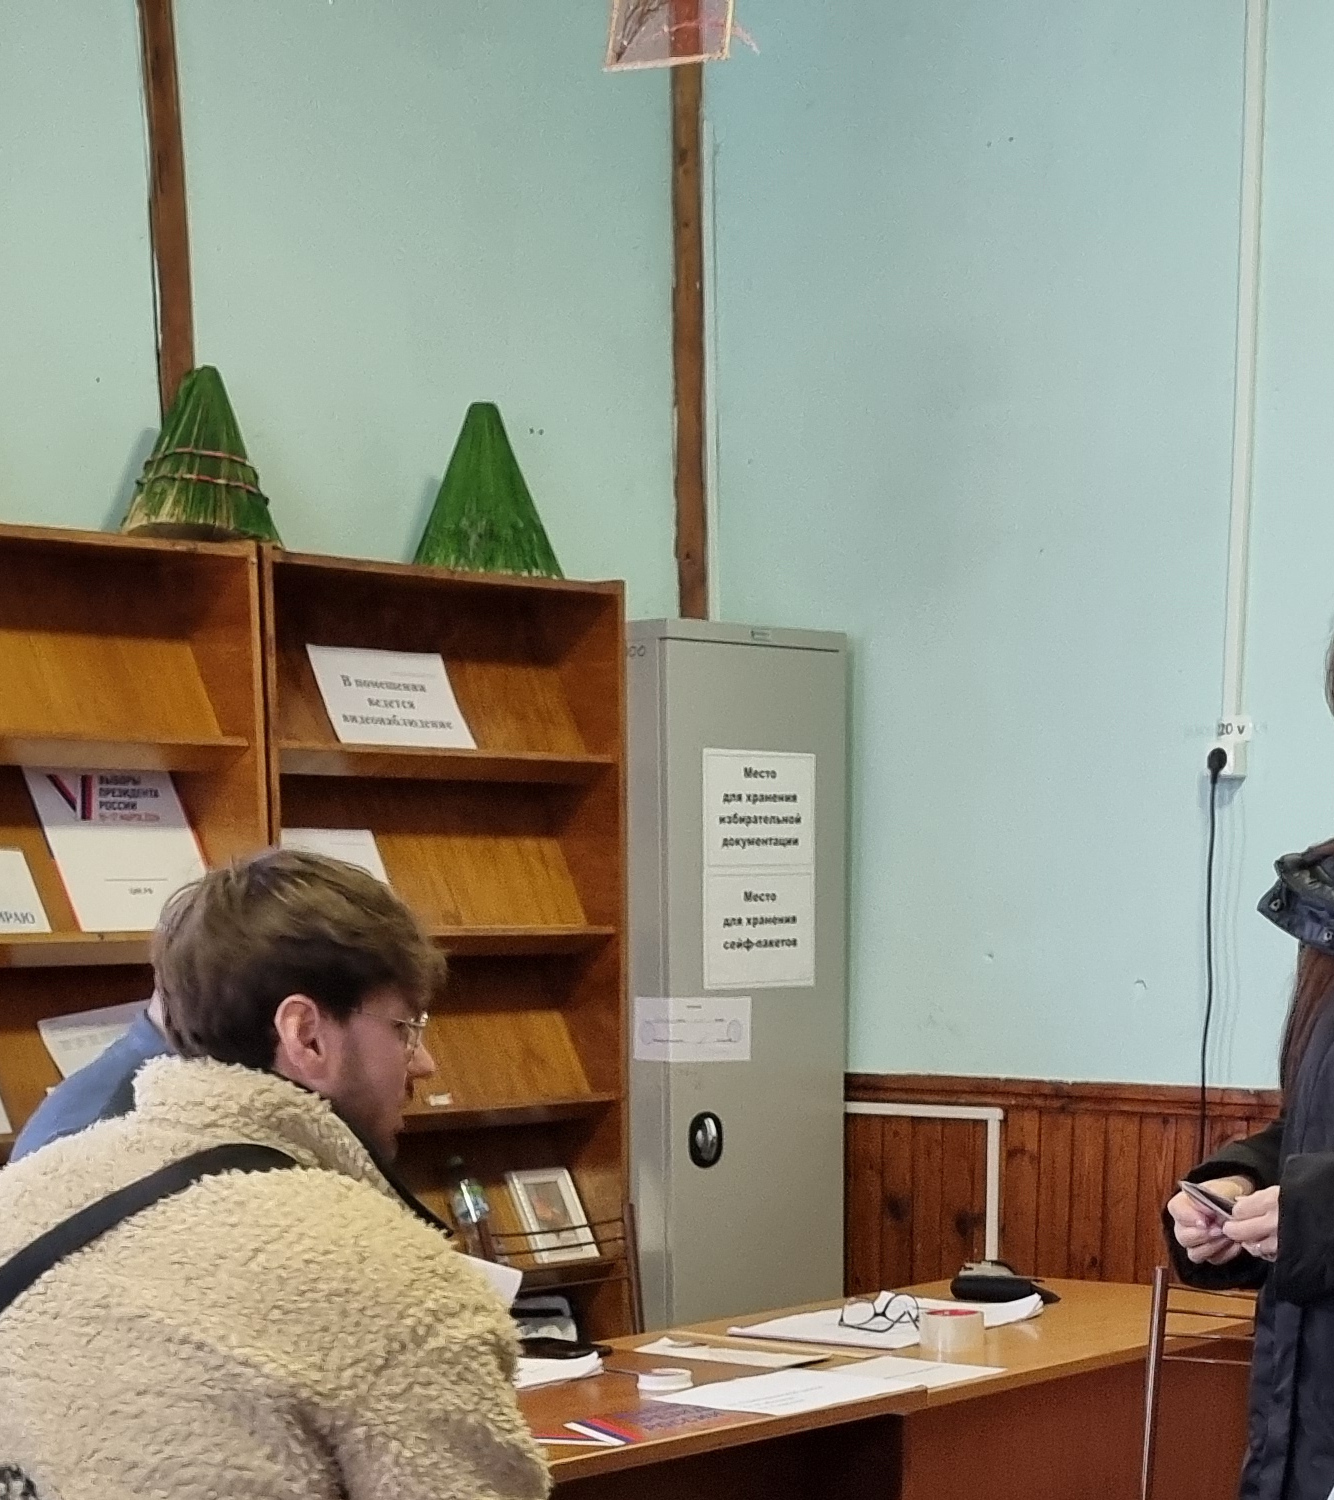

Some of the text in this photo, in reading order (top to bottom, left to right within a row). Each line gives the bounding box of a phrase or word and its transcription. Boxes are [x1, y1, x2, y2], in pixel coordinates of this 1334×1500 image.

[340, 674, 352, 687] В
[367, 697, 416, 710] ведется
[743, 766, 778, 779] Место
[98, 775, 142, 786] ВЫБОРЫ
[98, 787, 160, 799] ПРЕЗИДЕНТА
[722, 792, 798, 805] для хранения
[98, 800, 138, 811] РОССИИ
[718, 812, 802, 827] избирательной
[721, 837, 800, 850] документации
[743, 890, 777, 902] Место
[722, 915, 798, 928] для хранения
[722, 938, 798, 952] сейф-пакетов
